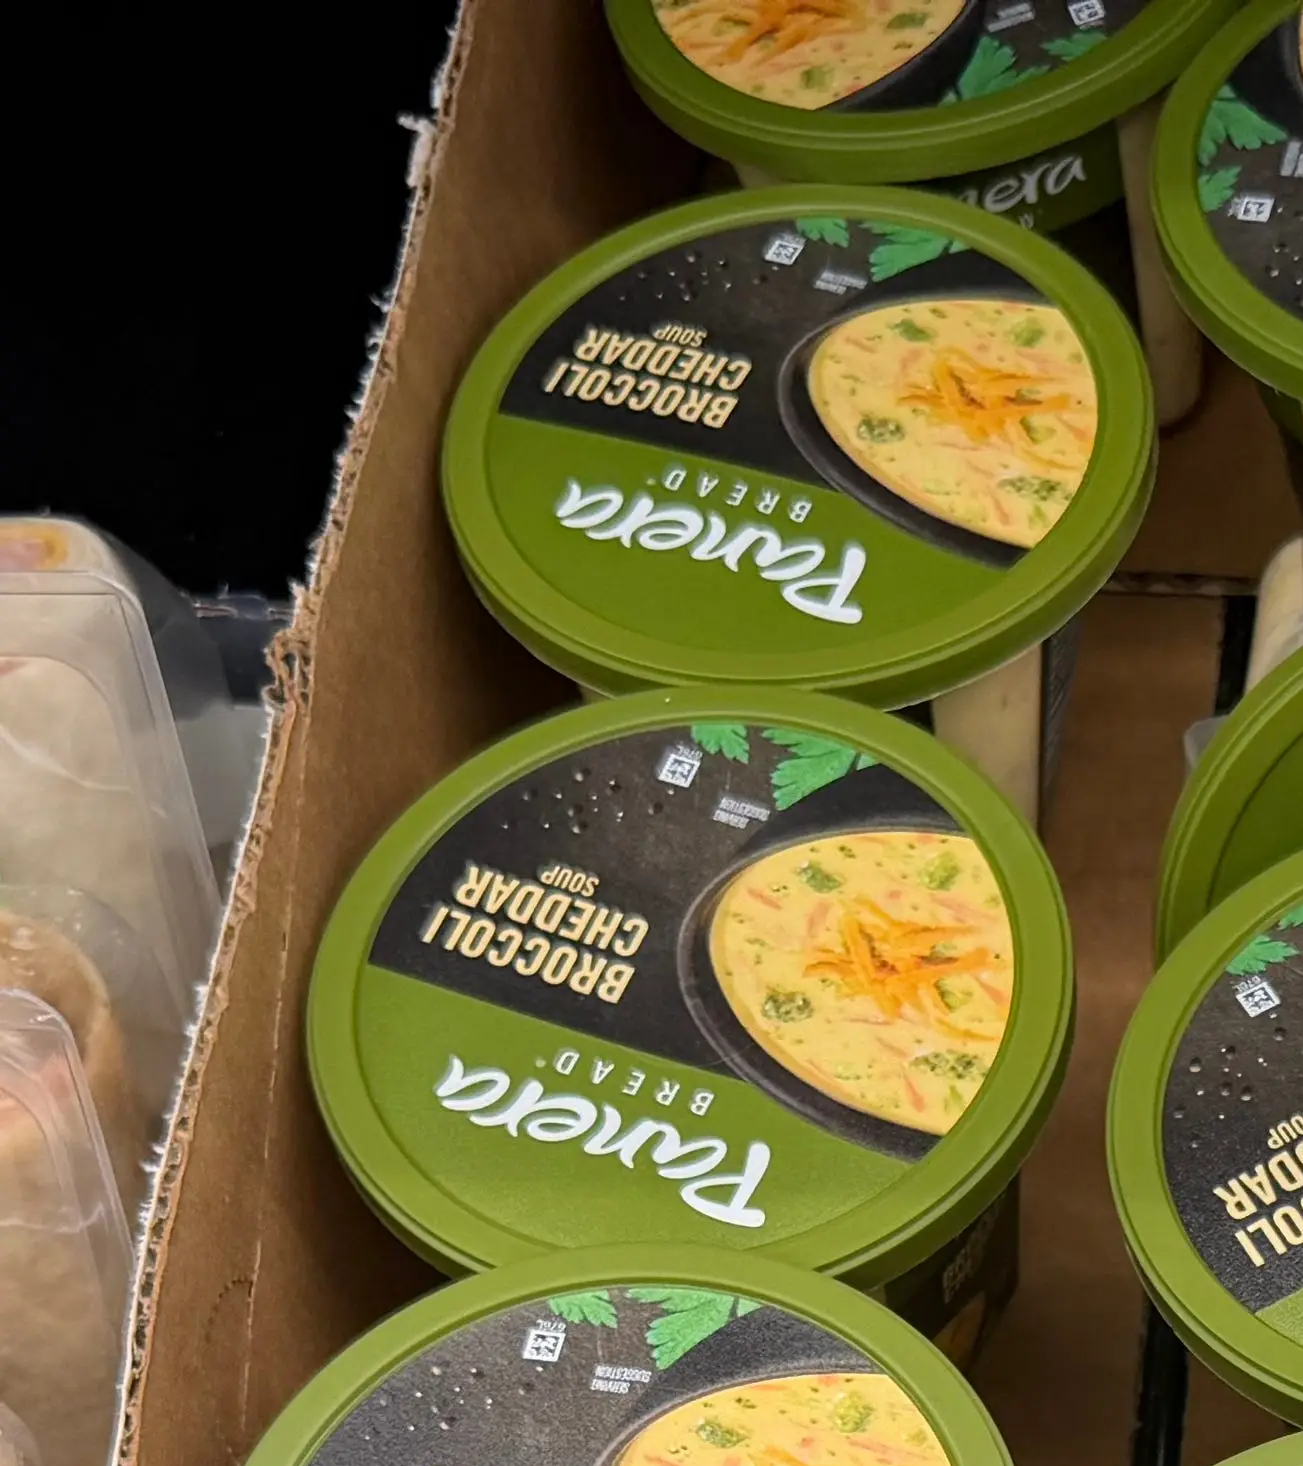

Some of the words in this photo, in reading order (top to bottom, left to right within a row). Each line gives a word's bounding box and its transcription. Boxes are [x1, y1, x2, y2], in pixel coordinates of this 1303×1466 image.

[575, 328, 751, 391] CHEDDAR
[655, 324, 706, 347] SOUP
[544, 359, 739, 428] BROCCOLI
[555, 480, 866, 625] Panera
[453, 863, 649, 957] CHEDDAR
[539, 862, 600, 895] SOUP
[421, 905, 635, 1004] BROCCOLI
[432, 1054, 770, 1228] Panera
